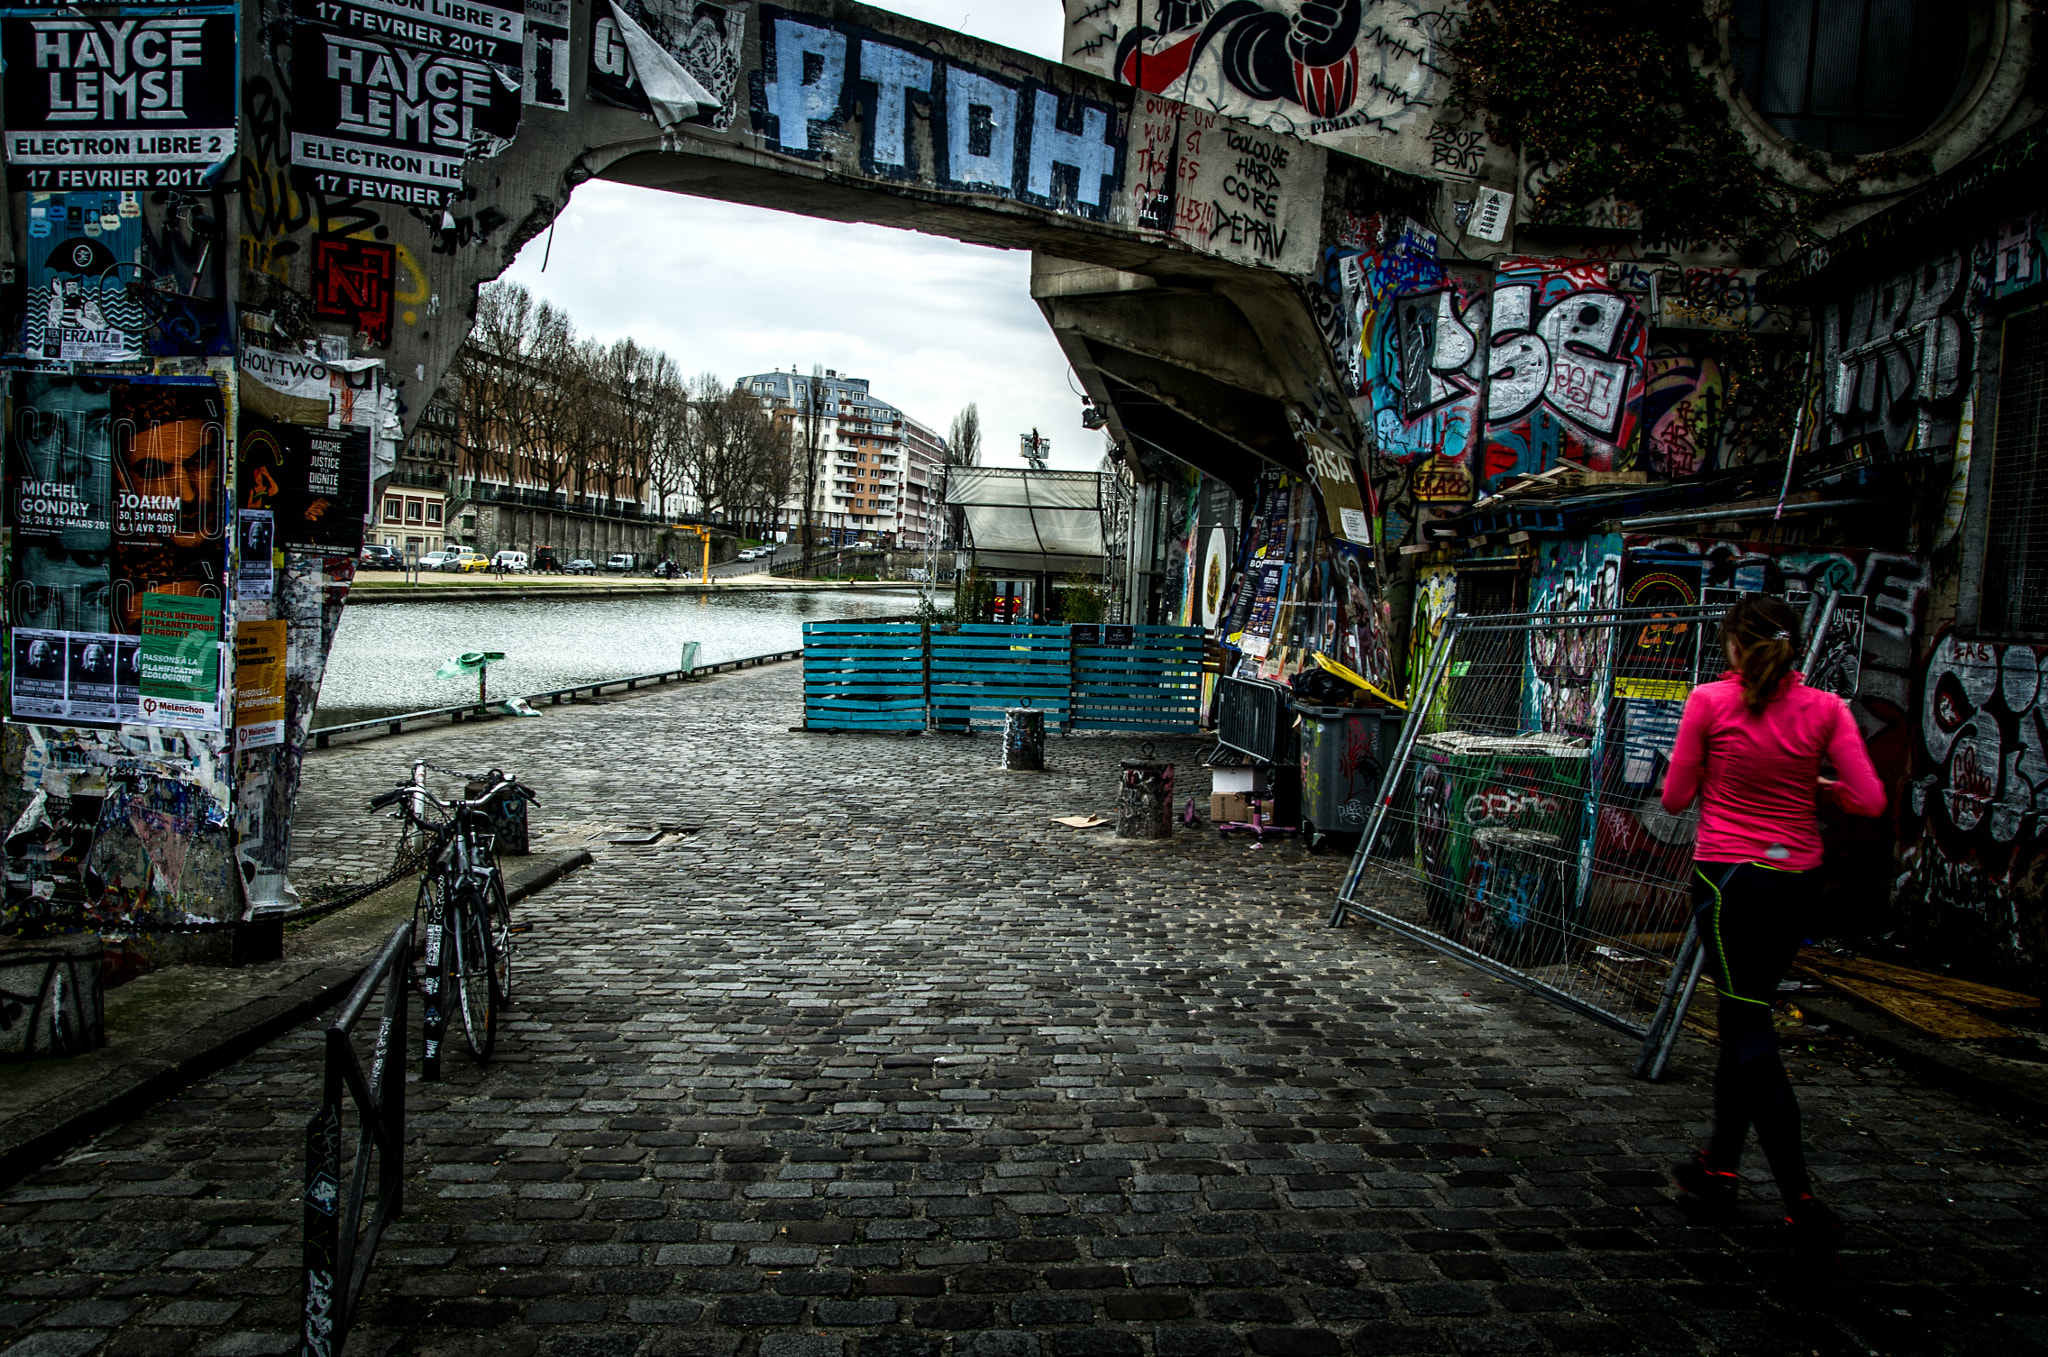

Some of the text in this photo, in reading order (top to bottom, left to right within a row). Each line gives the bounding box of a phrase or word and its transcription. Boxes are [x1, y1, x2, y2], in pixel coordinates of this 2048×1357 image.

[316, 2, 342, 22] 17
[349, 9, 443, 46] FEVRIER
[449, 32, 498, 57] 2017
[500, 16, 512, 33] 2
[31, 19, 206, 77] HAYCE
[322, 33, 493, 107] HAYCE
[45, 71, 188, 120] LEMSI
[335, 84, 474, 150] LEMSI
[1195, 110, 1216, 129] UN
[15, 136, 221, 155] ELECTRON LIBRE 2
[303, 142, 461, 179] ELECTRON LIB
[27, 169, 206, 188] 17 FEVRIER 2017
[1235, 157, 1281, 191] HARD
[315, 174, 441, 206] 17 FEVRIER
[1224, 175, 1278, 217] CORE
[63, 329, 110, 343] ERZATZ
[242, 350, 327, 380] HOLY TWO
[273, 378, 289, 386] TOUR
[311, 439, 341, 453] MARCHE
[310, 455, 340, 469] JUSTICE
[309, 472, 339, 486] DIGNITÉ
[22, 480, 78, 499] MICHEL
[21, 498, 89, 517] GONDRY
[119, 493, 180, 511] JOAKIM
[66, 519, 93, 529] MARS
[148, 513, 174, 522] MARS
[136, 524, 154, 533] AVR
[156, 525, 177, 533] 2017
[144, 609, 215, 623] FAUT-IL DÉTRUIRE
[155, 619, 190, 629] PLANÈTE
[192, 622, 215, 631] POUR
[154, 628, 182, 637] PROFIT
[142, 653, 180, 664] PASSONS
[188, 658, 198, 666] LA
[142, 663, 203, 676] PLANIFICATION
[159, 702, 205, 714] Mélenchon
